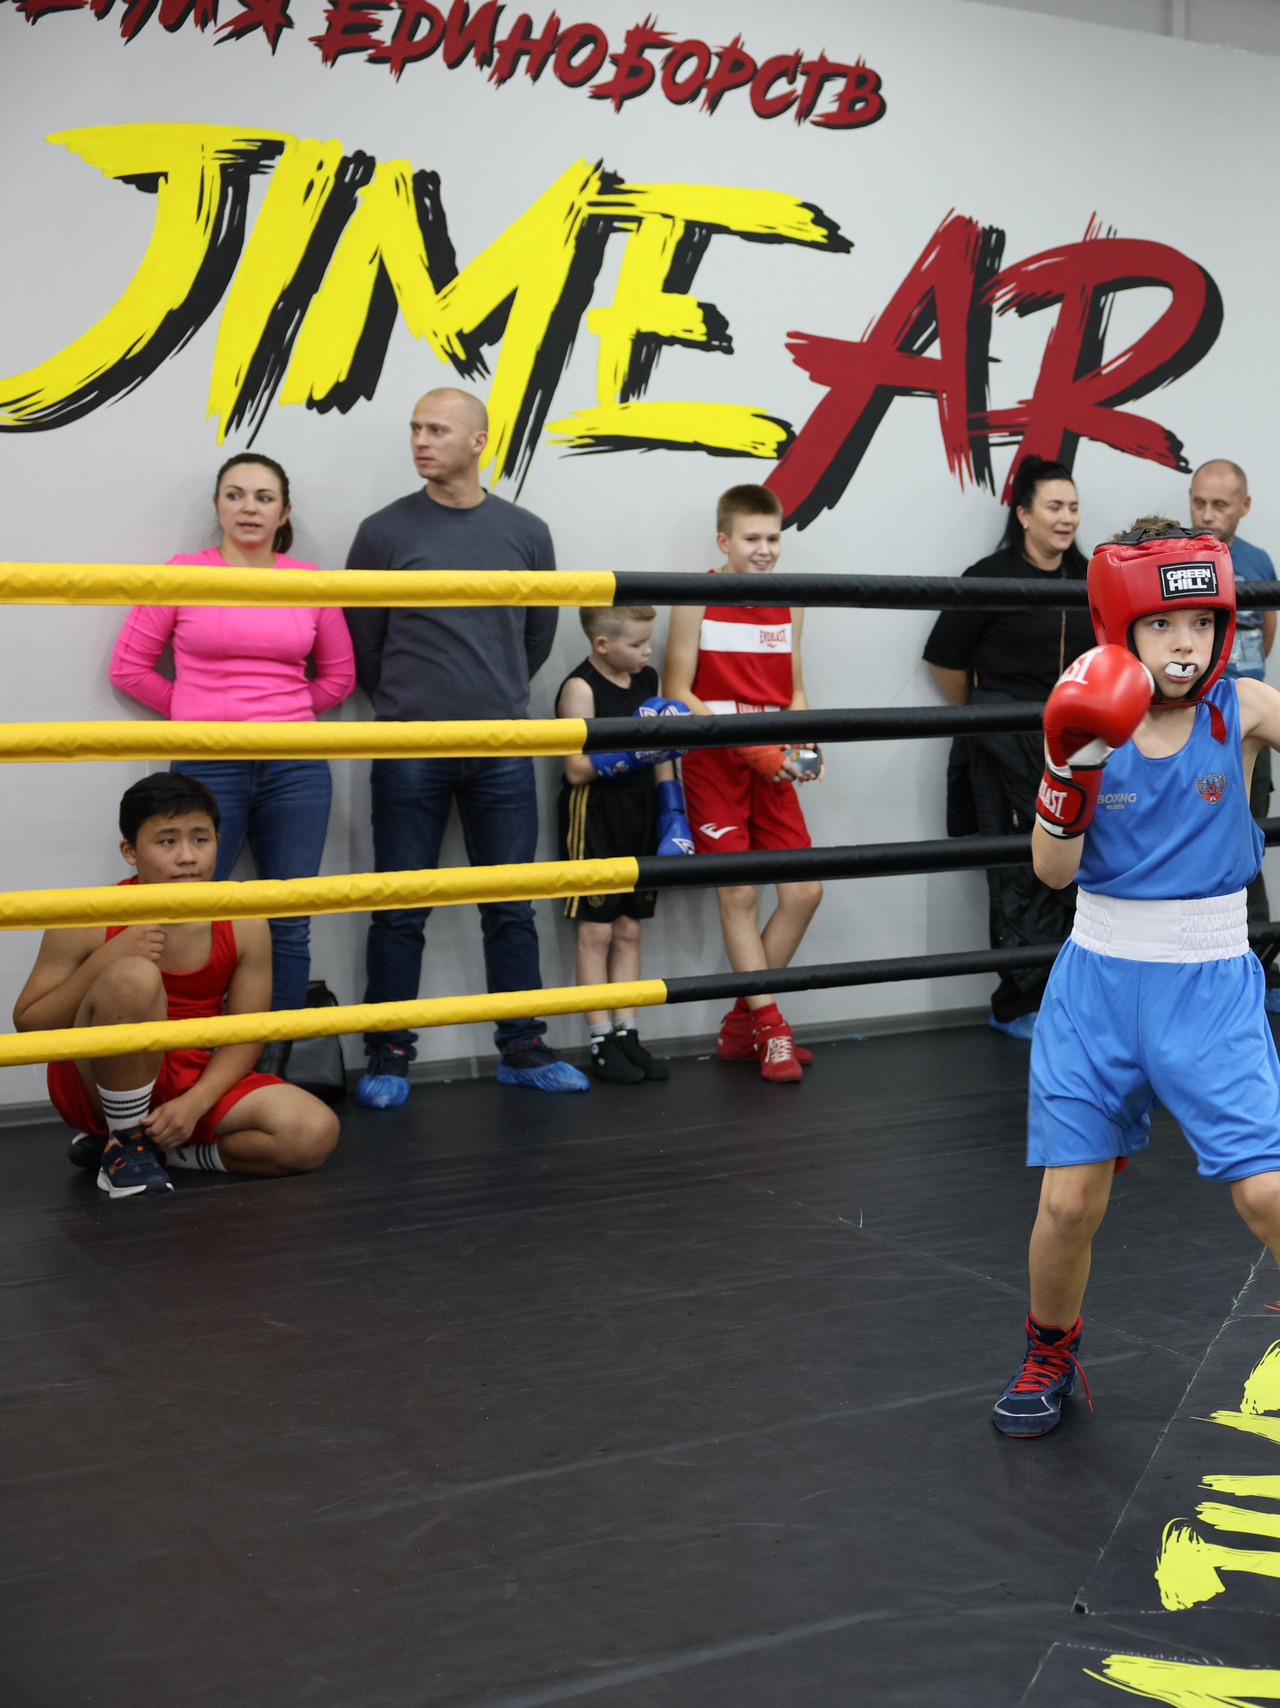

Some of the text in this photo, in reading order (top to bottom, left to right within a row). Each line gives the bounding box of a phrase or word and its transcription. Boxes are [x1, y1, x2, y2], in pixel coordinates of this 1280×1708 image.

[1166, 568, 1211, 581] GREEN
[1169, 577, 1208, 592] HILL
[760, 628, 787, 644] EVERLAST
